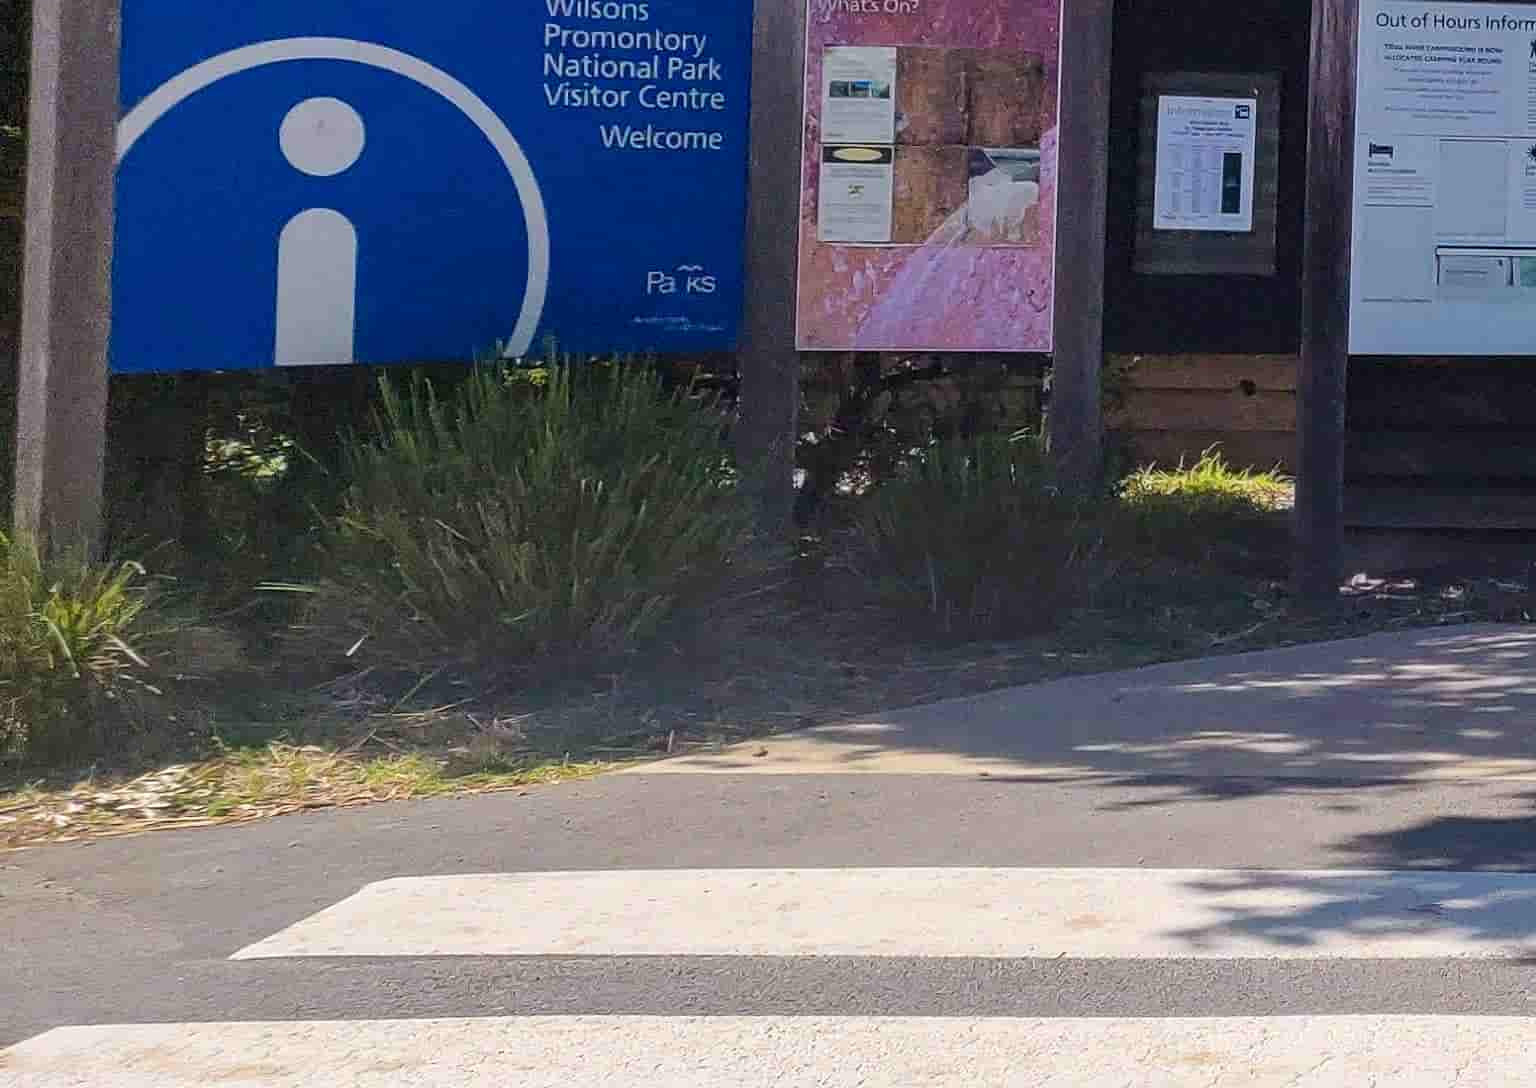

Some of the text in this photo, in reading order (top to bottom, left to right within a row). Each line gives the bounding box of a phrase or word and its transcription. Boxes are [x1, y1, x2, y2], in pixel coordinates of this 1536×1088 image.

[1375, 12, 1407, 29] Out
[1410, 12, 1430, 29] of
[1433, 13, 1481, 31] Hours
[543, 23, 707, 58] Promontory
[543, 53, 722, 81] National Park
[543, 81, 726, 110] Visitor Centre
[599, 123, 723, 151] Welcome
[647, 269, 717, 295] Paks
